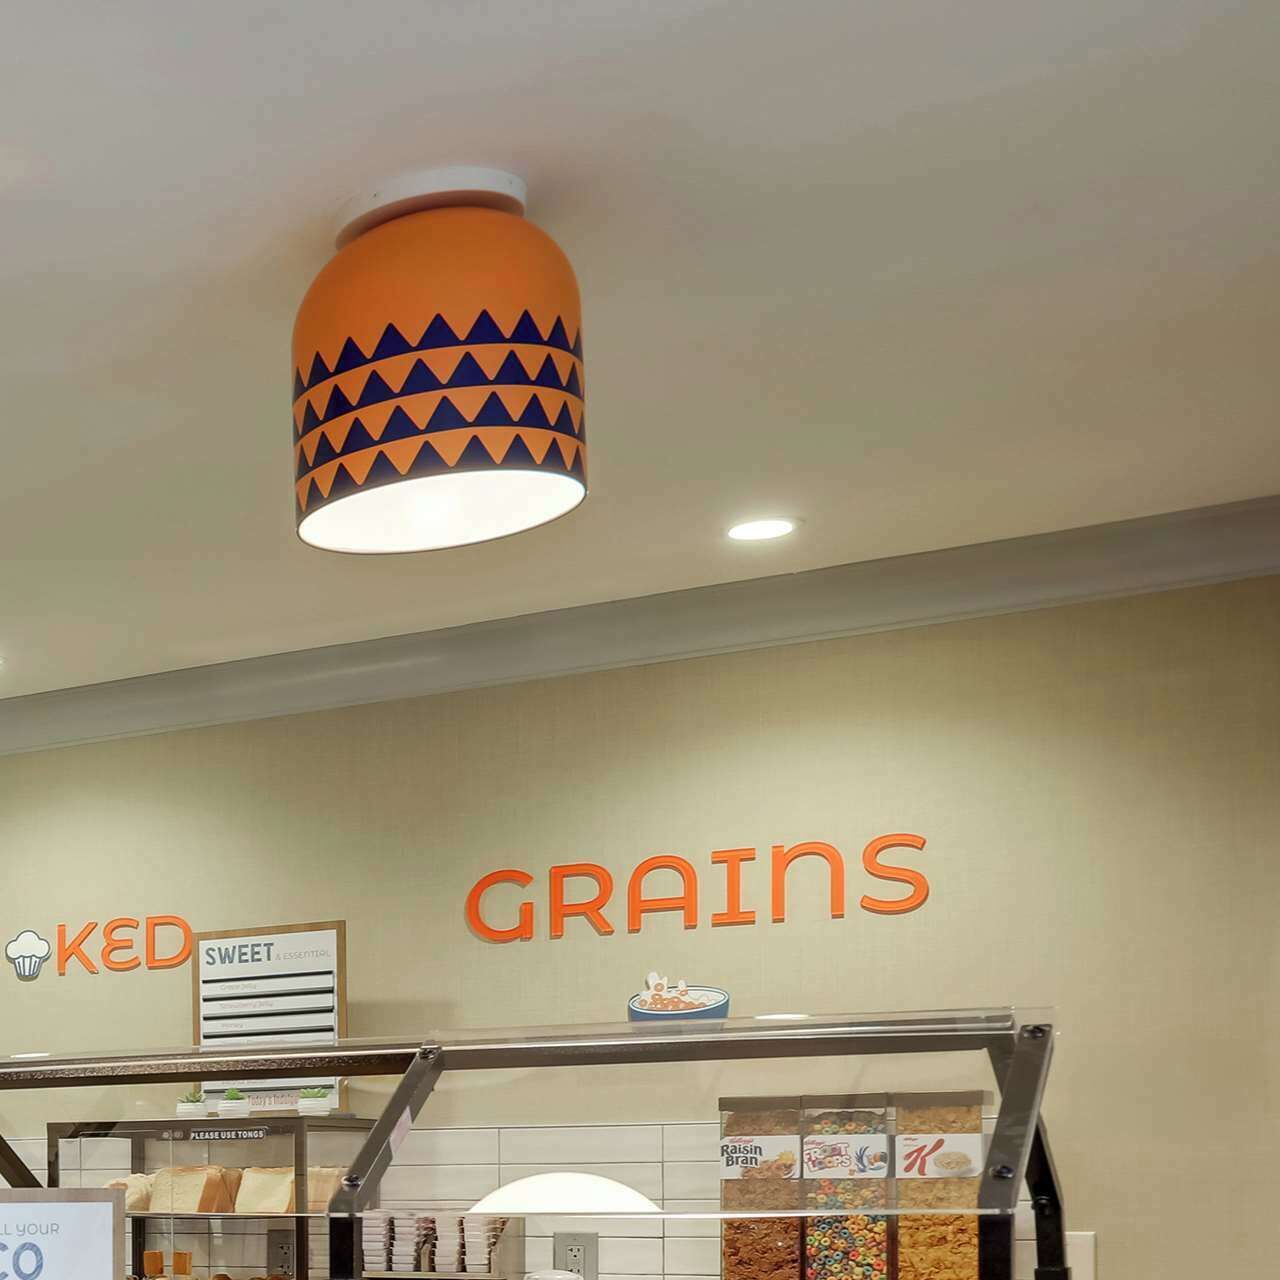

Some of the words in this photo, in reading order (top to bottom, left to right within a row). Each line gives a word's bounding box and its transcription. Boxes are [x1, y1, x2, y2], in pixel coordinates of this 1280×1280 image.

[464, 832, 930, 943] GRAINS
[205, 943, 274, 966] SWEET
[191, 1131, 219, 1140] PLEASE
[221, 1131, 236, 1139] USE
[237, 1130, 264, 1139] TONGS
[720, 1144, 763, 1157] Raisin
[904, 1138, 944, 1176] K
[725, 1154, 759, 1167] Bran
[16, 1222, 60, 1237] YOUR
